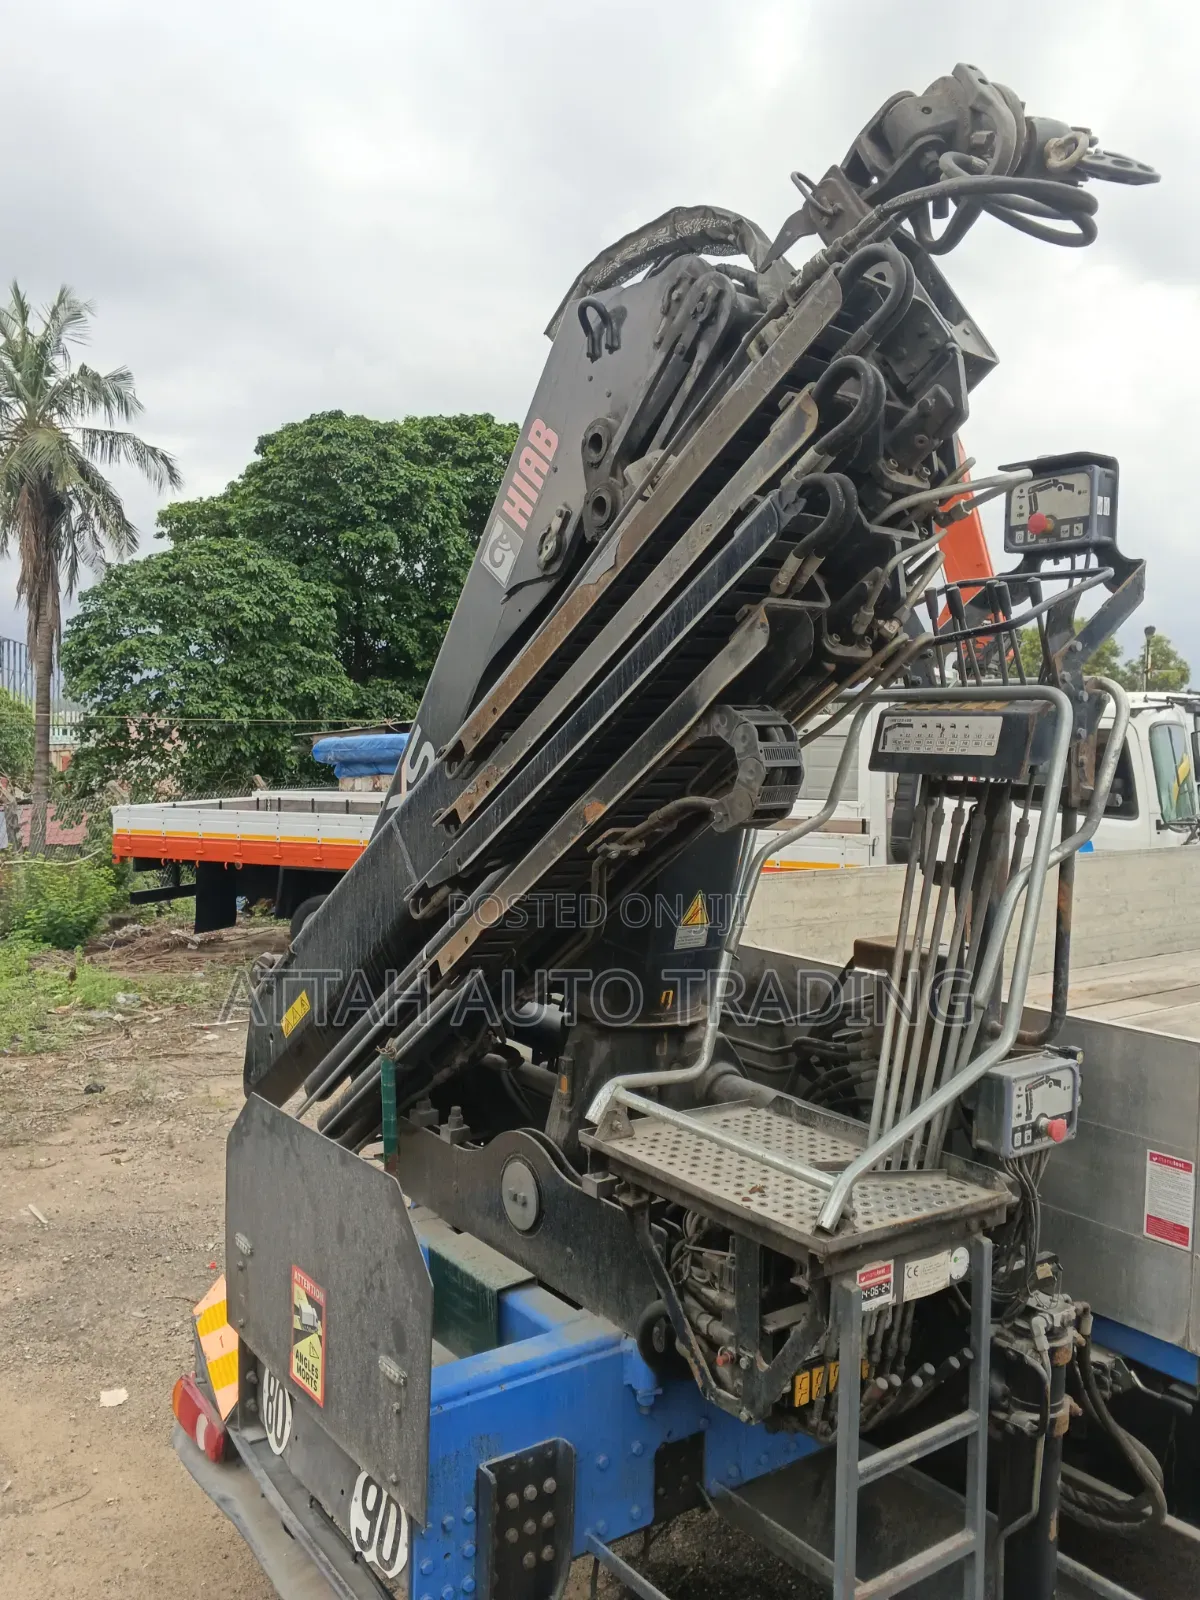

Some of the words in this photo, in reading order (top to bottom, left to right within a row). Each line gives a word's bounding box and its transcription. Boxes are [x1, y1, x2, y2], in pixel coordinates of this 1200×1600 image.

[501, 418, 559, 531] HIAB
[294, 1271, 325, 1303] ATTENTION
[906, 1265, 920, 1279] CE
[295, 1348, 319, 1380] ANGLES
[296, 1361, 318, 1392] MORTS
[266, 1371, 287, 1448] 80
[355, 1475, 401, 1572] 90
